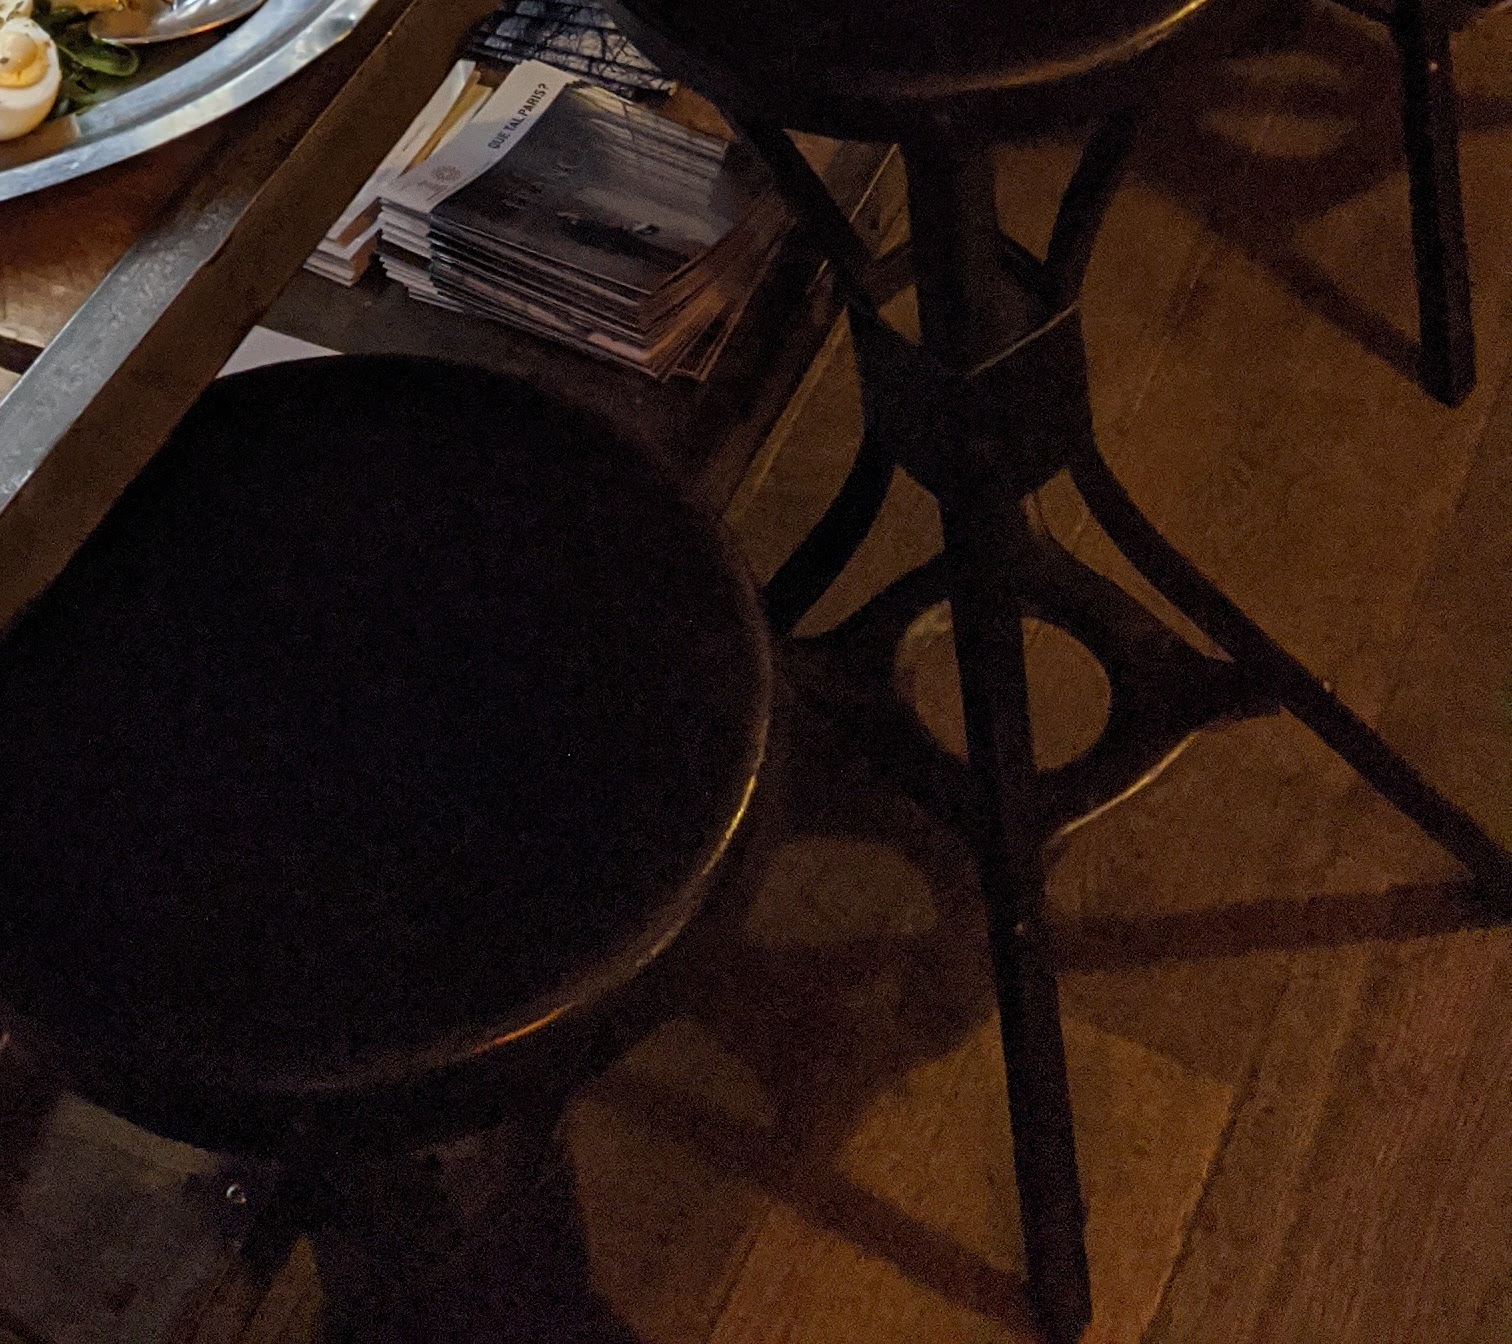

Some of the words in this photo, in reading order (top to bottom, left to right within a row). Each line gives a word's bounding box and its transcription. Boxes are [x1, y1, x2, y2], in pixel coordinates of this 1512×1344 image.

[487, 131, 511, 149] QUE
[503, 117, 526, 132] TAL
[517, 83, 550, 117] PARIS?
